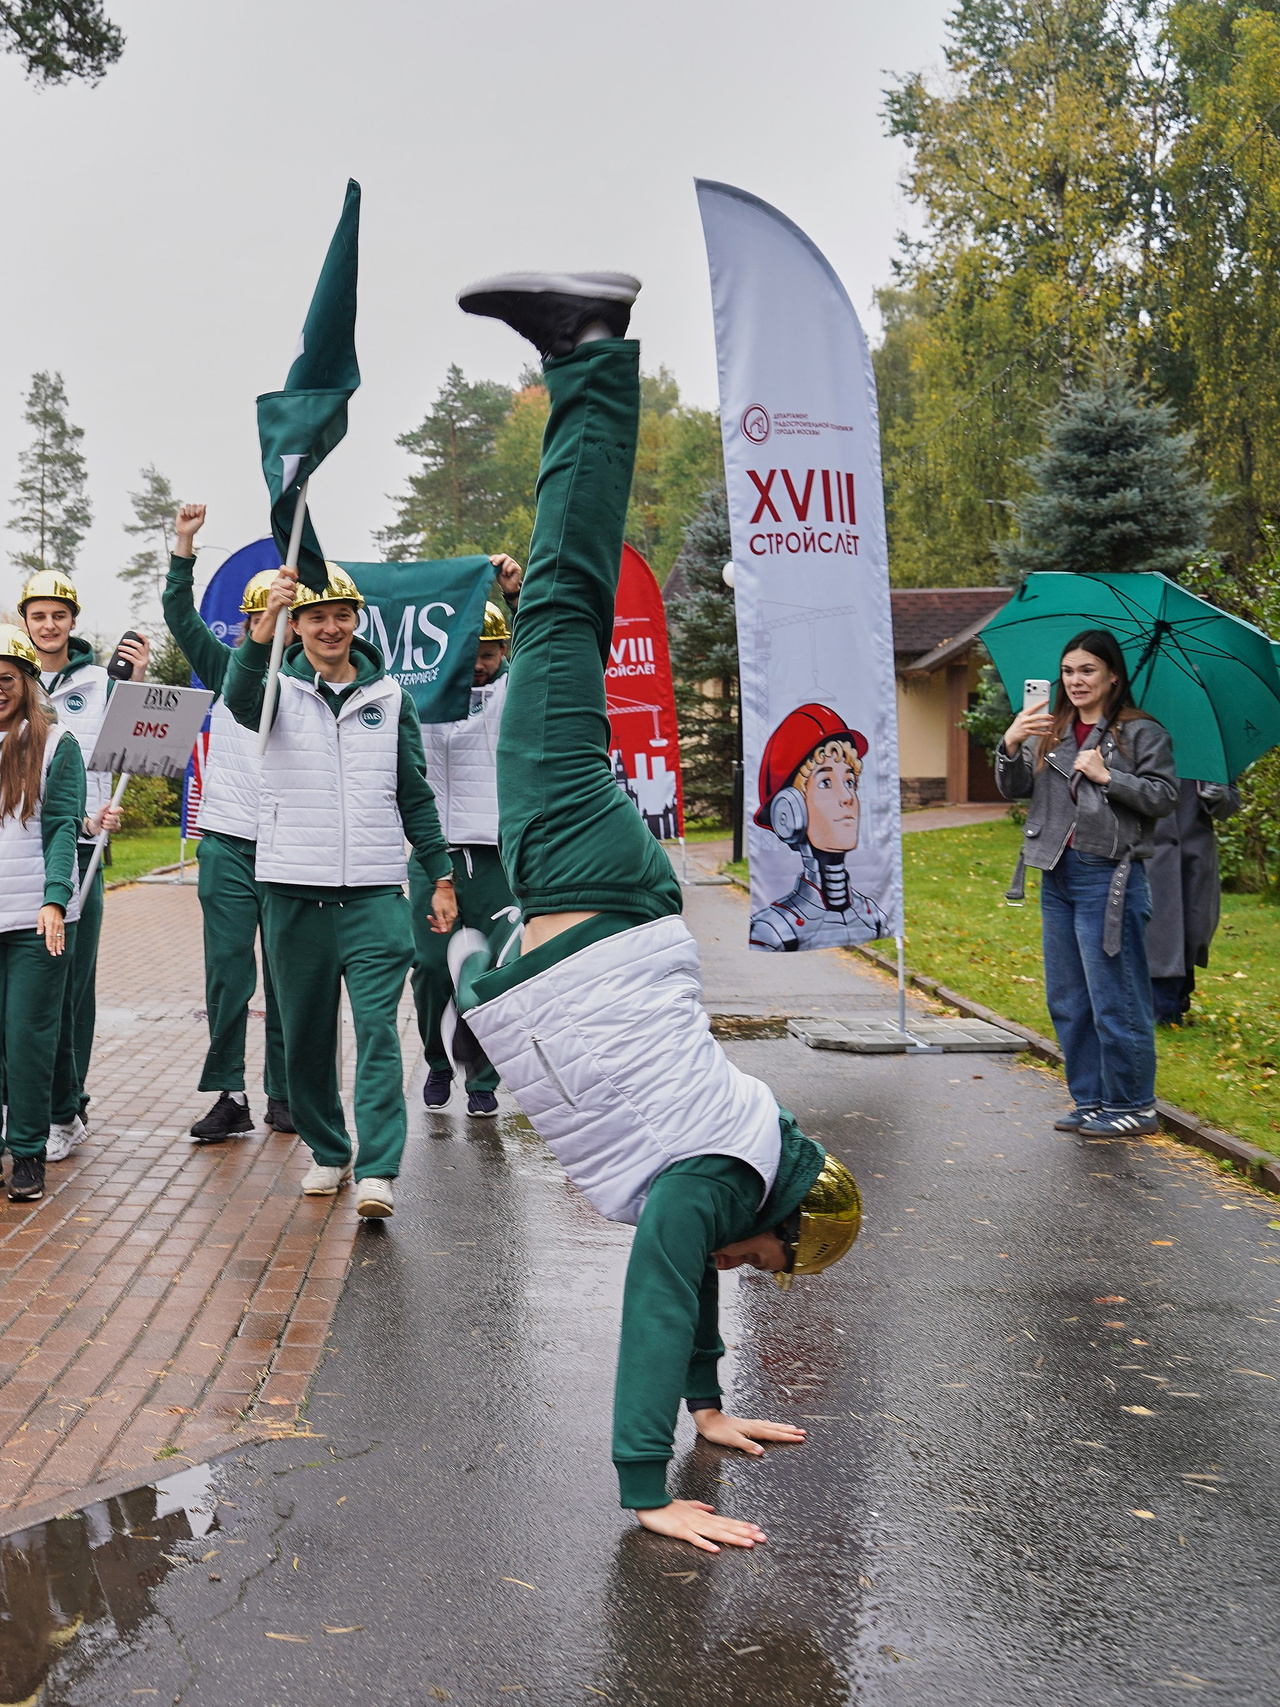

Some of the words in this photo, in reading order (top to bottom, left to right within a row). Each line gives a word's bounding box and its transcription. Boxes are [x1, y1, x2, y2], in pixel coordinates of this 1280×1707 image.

[746, 469, 856, 525] XVIII
[749, 526, 859, 556] СТРОЙСЛЁТ
[144, 687, 182, 708] BMS
[362, 712, 382, 720] BMS
[132, 721, 170, 739] BMS
